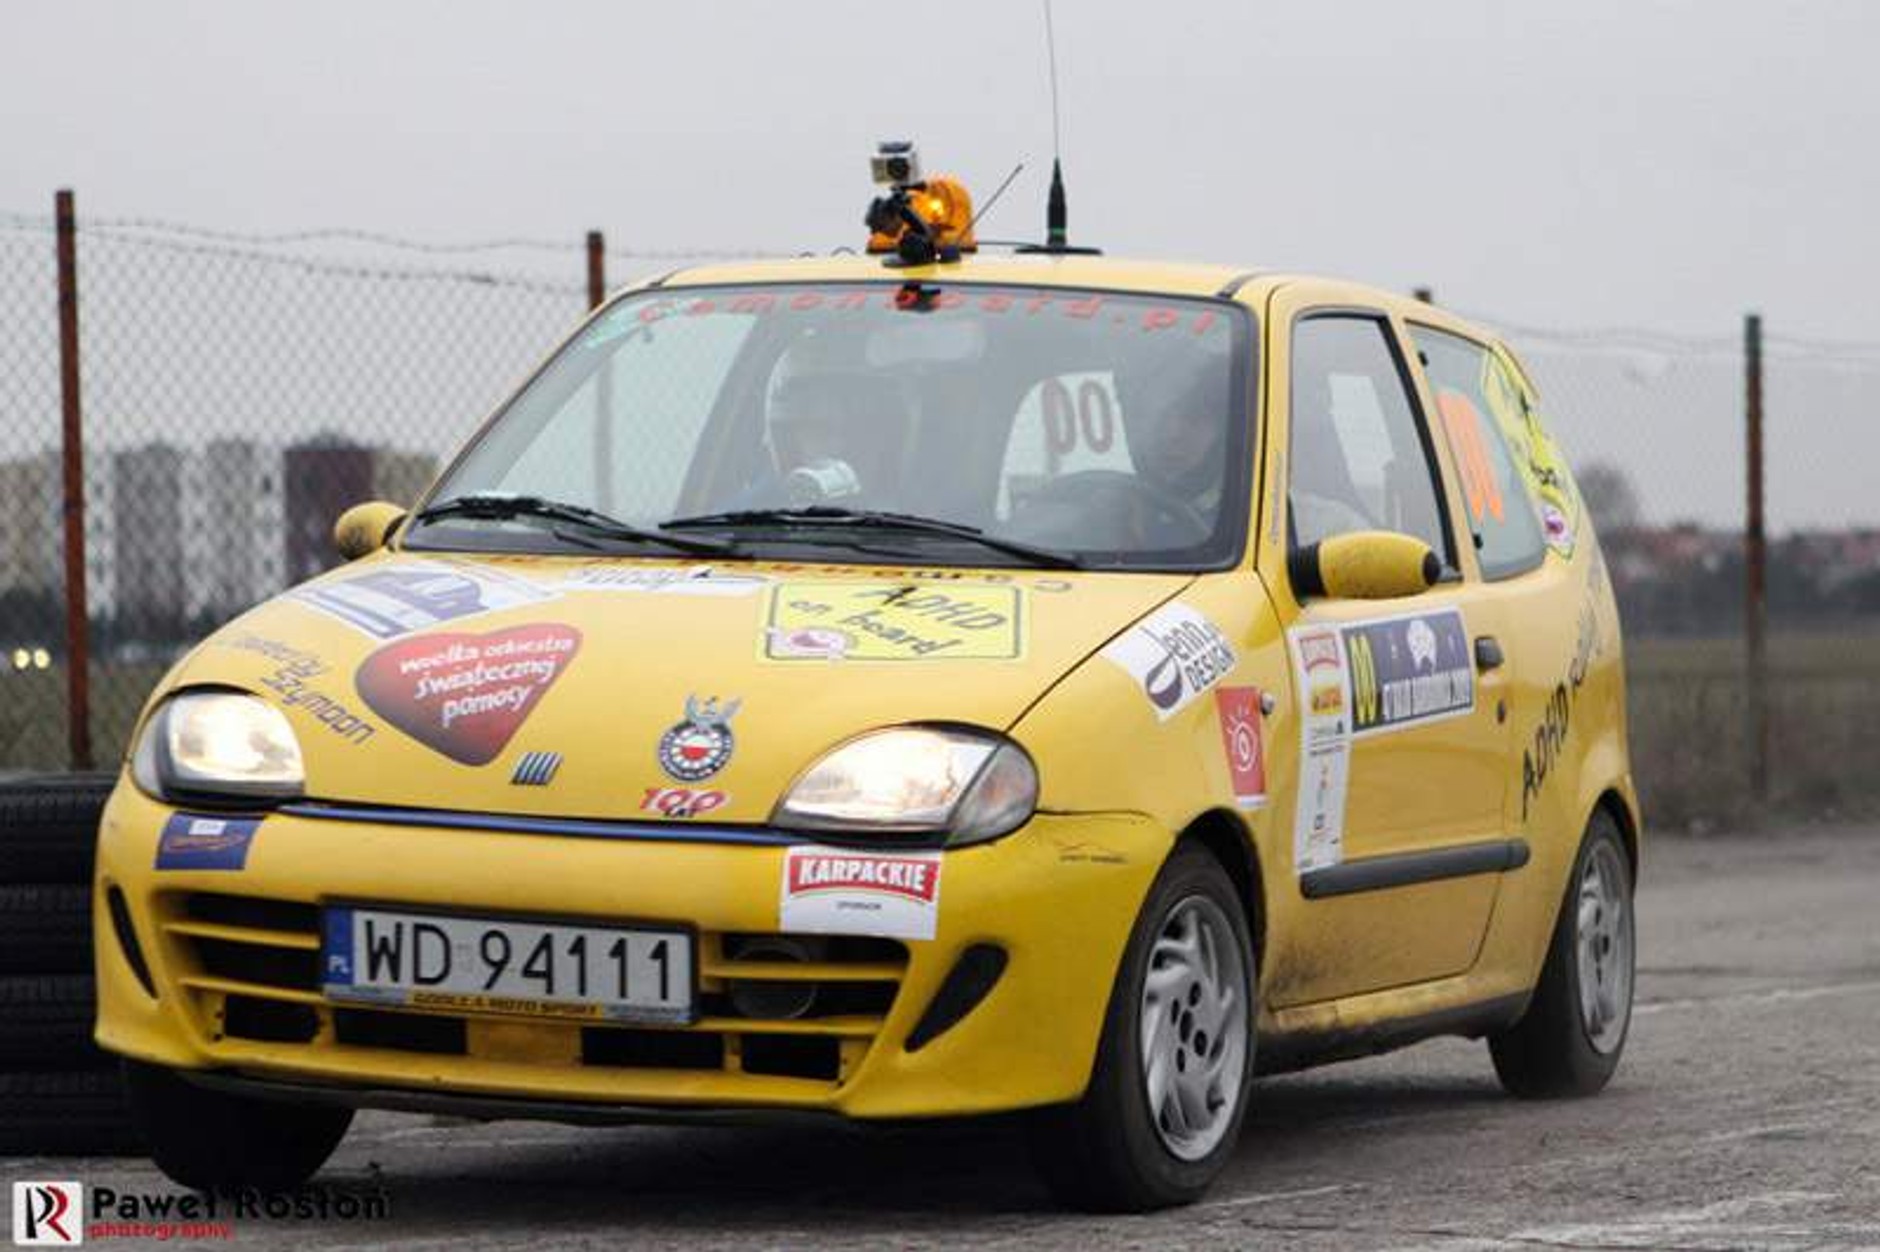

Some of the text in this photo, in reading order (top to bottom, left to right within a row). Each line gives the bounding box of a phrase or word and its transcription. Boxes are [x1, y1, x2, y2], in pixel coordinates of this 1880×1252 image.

[838, 610, 963, 655] board
[441, 685, 533, 729] pomocy
[799, 858, 926, 892] KARPACKIE
[328, 955, 351, 974] PL
[365, 920, 669, 1001] WD 94111
